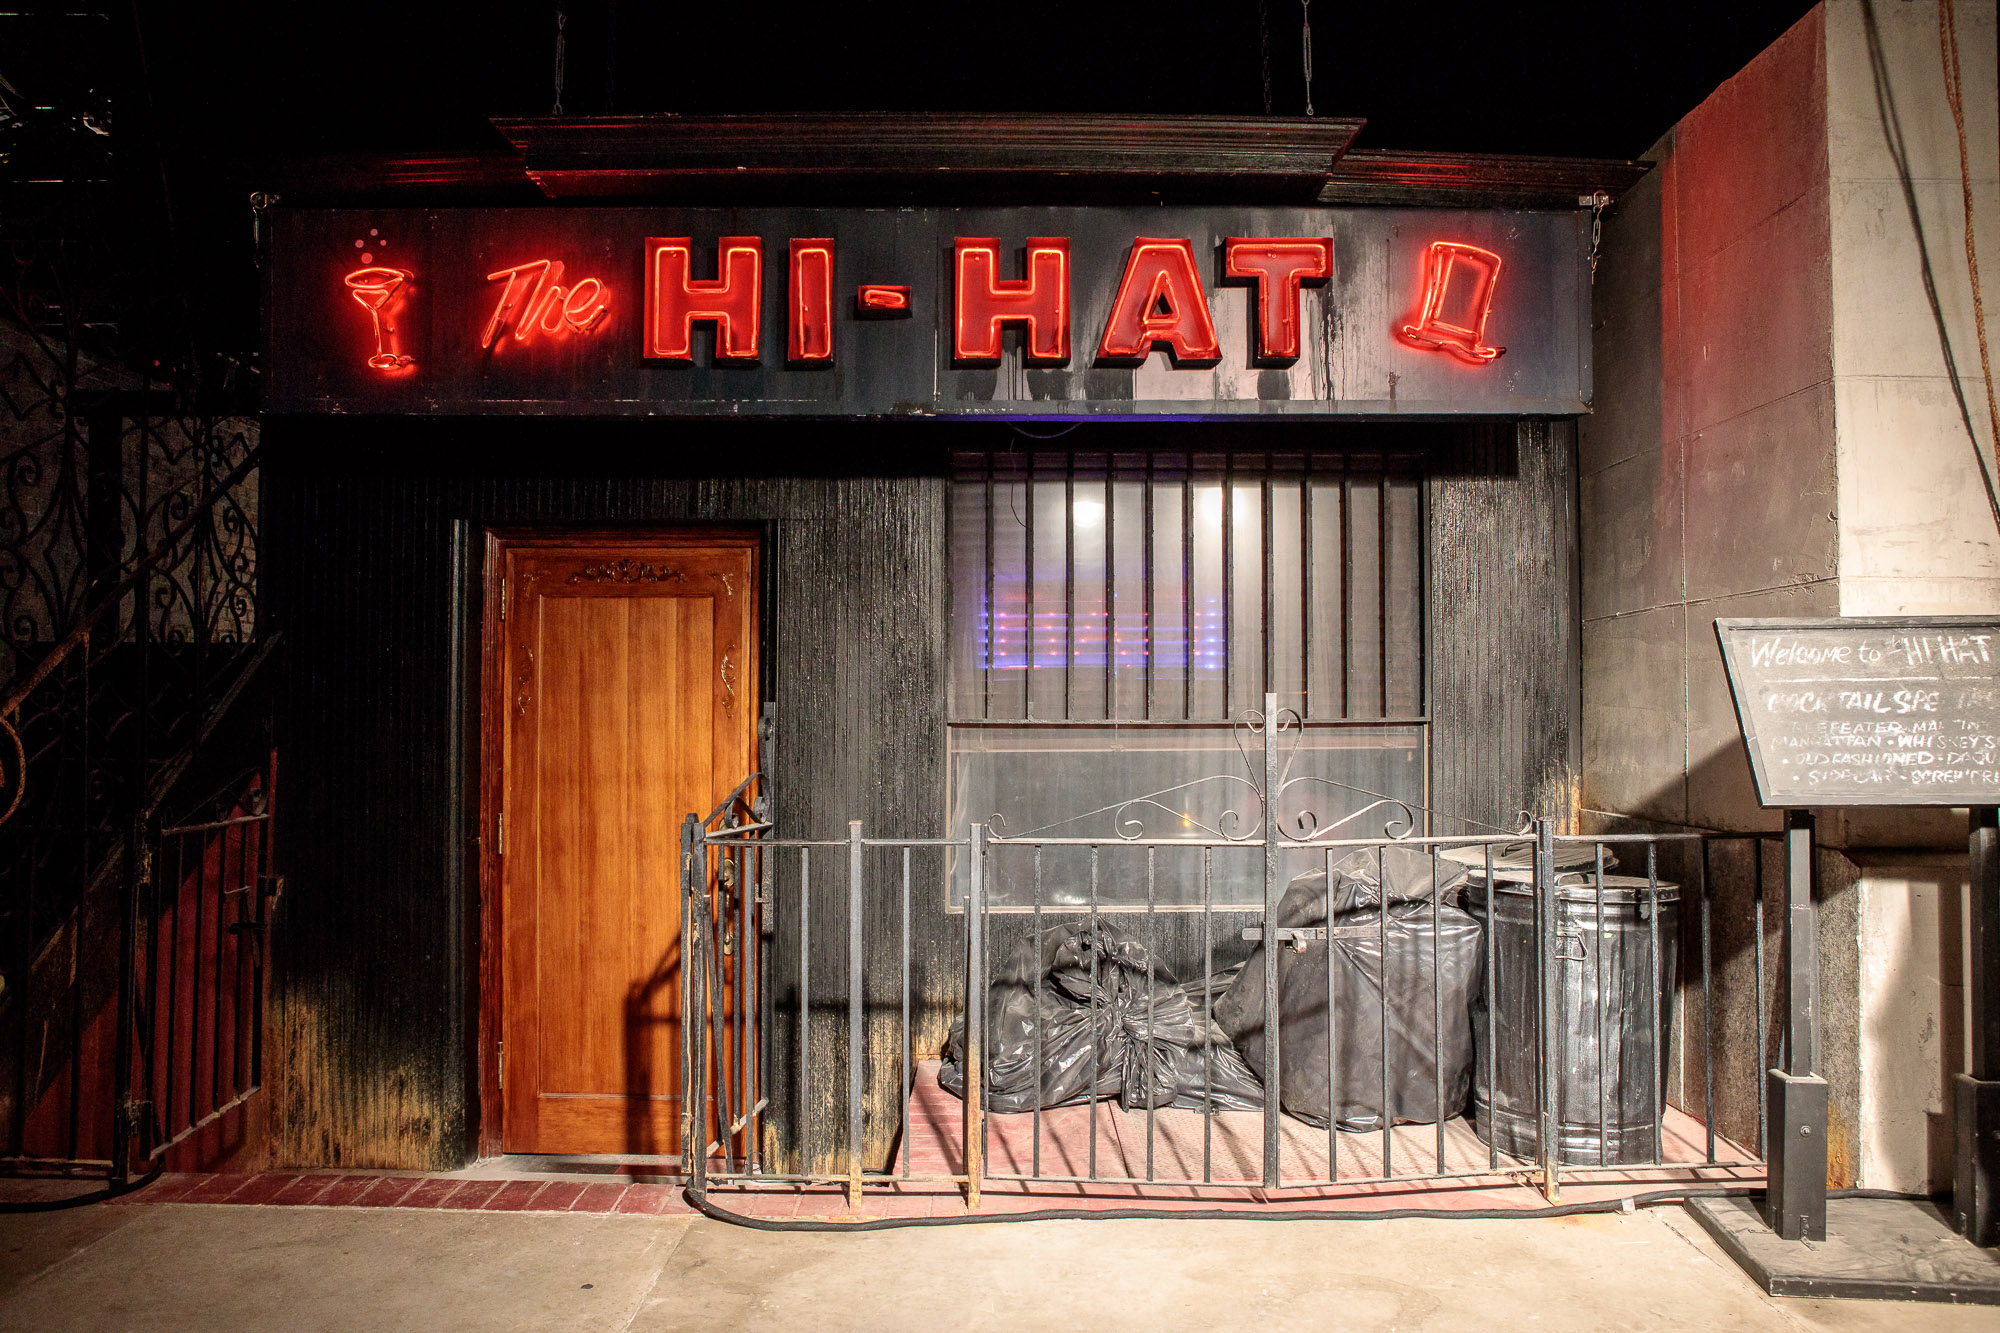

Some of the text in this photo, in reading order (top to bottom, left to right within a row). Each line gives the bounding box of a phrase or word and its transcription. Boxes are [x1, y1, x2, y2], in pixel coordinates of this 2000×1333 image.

[482, 258, 613, 350] The
[1751, 637, 1852, 668] Welcome
[1858, 640, 1881, 663] to
